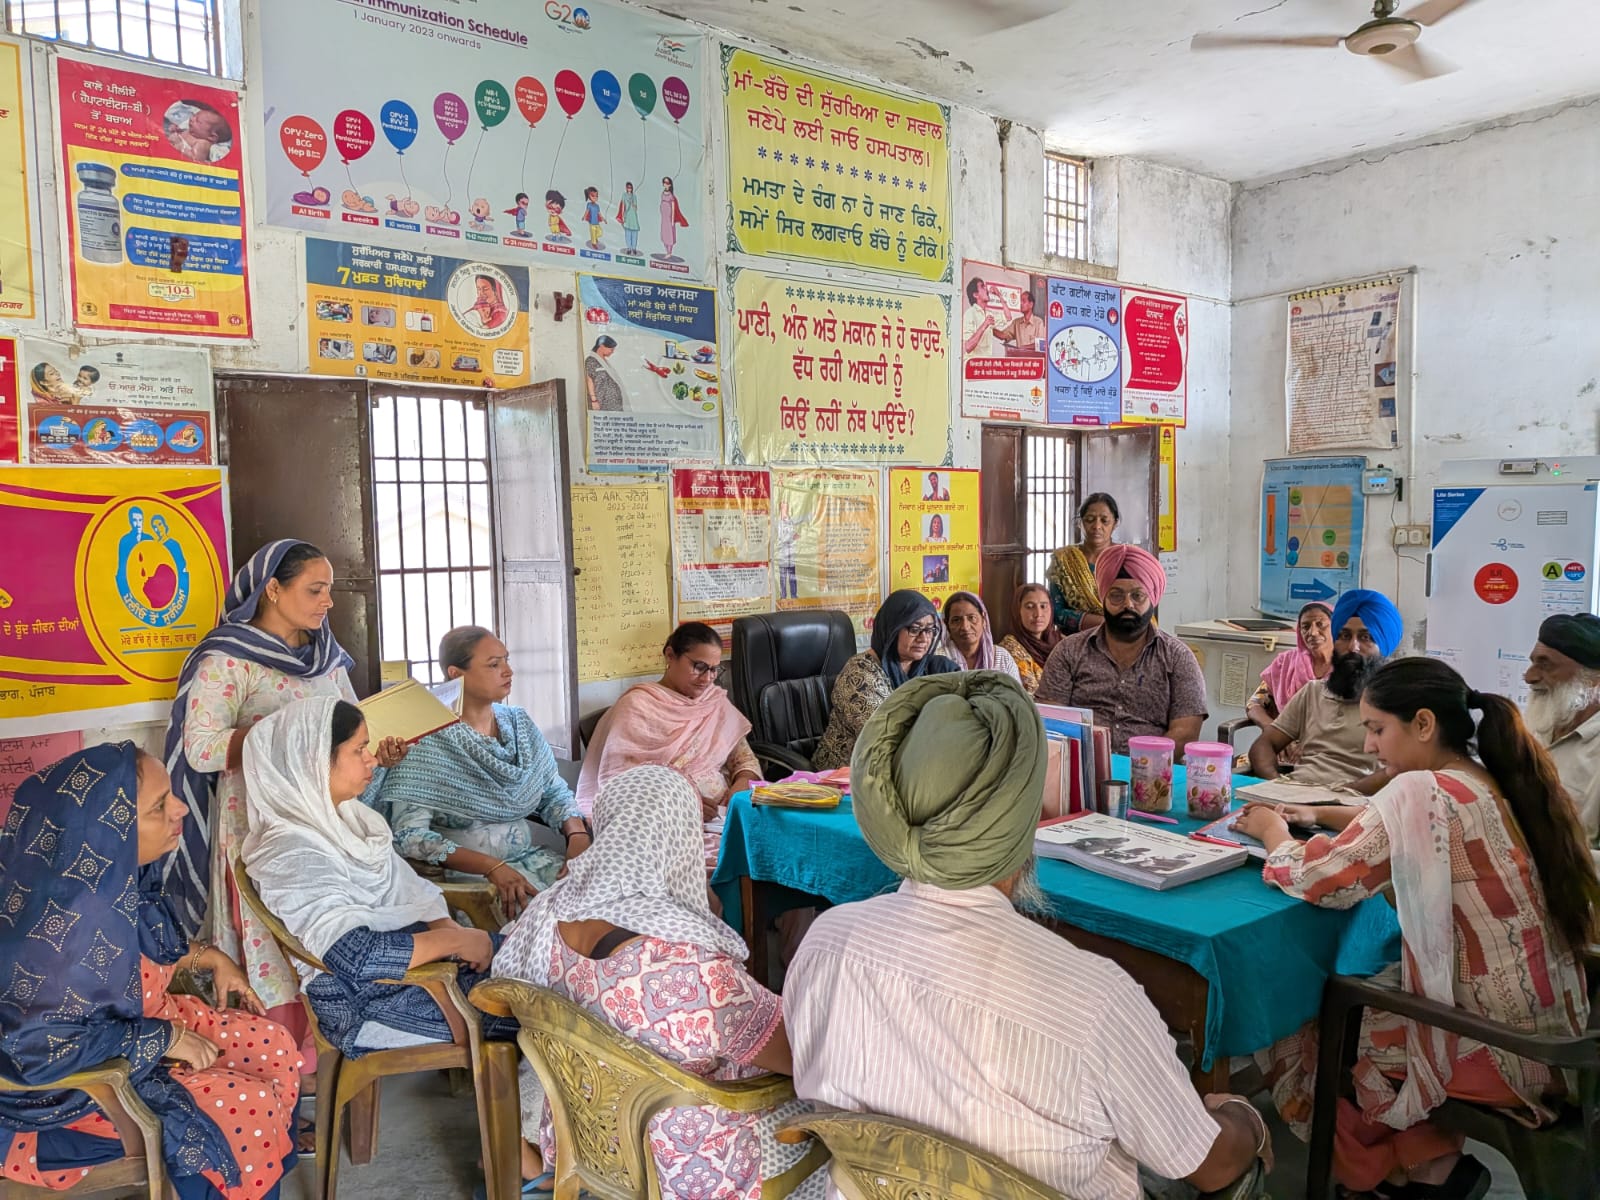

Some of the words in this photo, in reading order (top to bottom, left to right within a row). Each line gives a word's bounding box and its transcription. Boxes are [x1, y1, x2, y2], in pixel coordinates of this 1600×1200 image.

[545, 0, 591, 30] G20
[361, 12, 406, 32] January
[409, 23, 434, 38] 2023
[437, 32, 481, 50] onwards
[468, 19, 528, 45] Schedule
[734, 70, 788, 101] ਮਾਂ-ਬੱਚੇ
[796, 83, 814, 108] ਦੀ
[885, 110, 900, 128] ਦਾ
[906, 116, 942, 140] ਸਵਾਲ
[284, 127, 324, 140] OPV-Zero
[747, 106, 786, 134] ਜਣੇਪੇ
[794, 118, 824, 142] ਲਈ
[830, 127, 860, 150] ਜਾਓ
[296, 138, 312, 148] BCG
[288, 146, 305, 158] Hep
[743, 176, 786, 200] ਮਮਤਾ
[792, 179, 805, 204] ਦੇ
[812, 184, 836, 210] ਰੰਗ
[842, 195, 858, 214] ਨਾ
[863, 193, 874, 218] ਹੋ
[879, 203, 906, 224] ਜਾਣ
[308, 208, 324, 217] Birth
[352, 216, 374, 224] weeks
[395, 222, 416, 231] weeks
[436, 228, 456, 237] weeks
[776, 210, 804, 238] ਸਿਰ
[811, 222, 864, 247] ਲਗਵਾਓ
[869, 228, 890, 252] ਬੱਚੇ
[896, 232, 908, 262] ਨੂੰ
[352, 256, 382, 270] ਸਰਕਾਰੀ
[385, 262, 417, 276] ਹਸਪਤਾਲ
[416, 253, 434, 266] ਲਈ
[337, 266, 350, 286] 7
[166, 286, 190, 296] 104
[624, 283, 654, 296] ਗਰਭ
[656, 286, 698, 301] ਅਵਸਥਾ
[783, 304, 808, 340] ਅੰਨ
[813, 309, 838, 343] ਅਤੇ
[842, 320, 877, 348] ਮਕਾਨ
[881, 315, 892, 348] ਜੇ
[896, 316, 906, 350] ਹੋ
[792, 348, 814, 381] ਵੱਧ
[819, 349, 844, 382] ਰਹੀ
[848, 353, 888, 386] ਅਬਾਦੀ
[892, 354, 904, 398] ਨੂੰ
[780, 396, 810, 438] ਕਿਉਂ
[815, 398, 842, 432] ਨਹੀਂ
[1292, 464, 1329, 472] Temperature
[1330, 462, 1362, 470] Sensitivity
[1546, 564, 1560, 578] A
[32, 618, 56, 634] ਜੀਵਨ
[30, 684, 56, 698] ਪੰਜਾਬ
